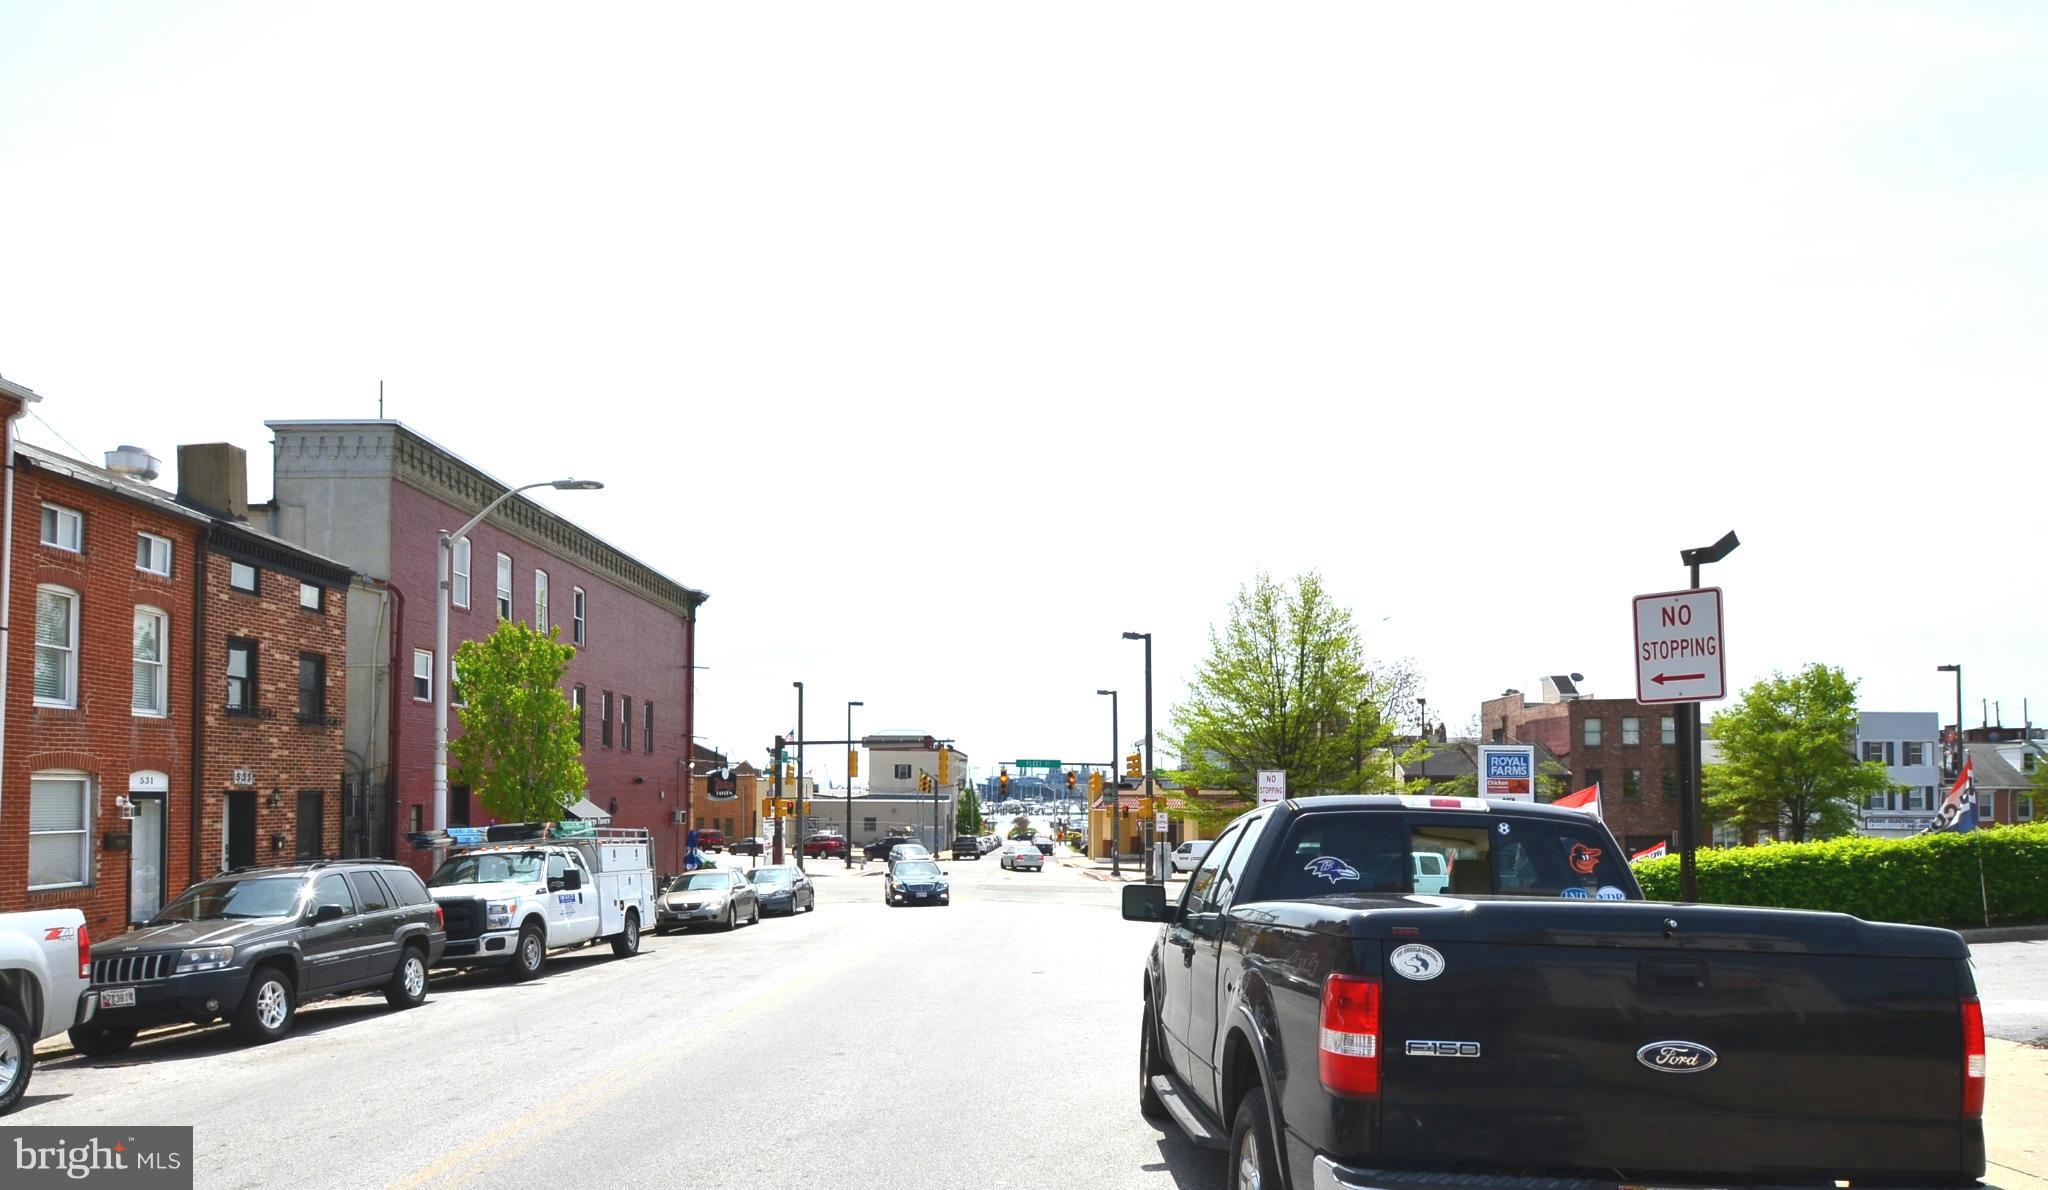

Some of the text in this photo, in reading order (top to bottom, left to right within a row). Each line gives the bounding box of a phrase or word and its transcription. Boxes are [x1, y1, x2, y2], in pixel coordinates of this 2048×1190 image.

[1662, 605, 1691, 627] NO
[1642, 636, 1716, 660] STOPPING
[1491, 756, 1527, 766] ROYAL
[1491, 766, 1527, 776] FARMS
[140, 776, 154, 785] 531
[1266, 775, 1277, 783] NO
[1656, 1046, 1700, 1066] Ford
